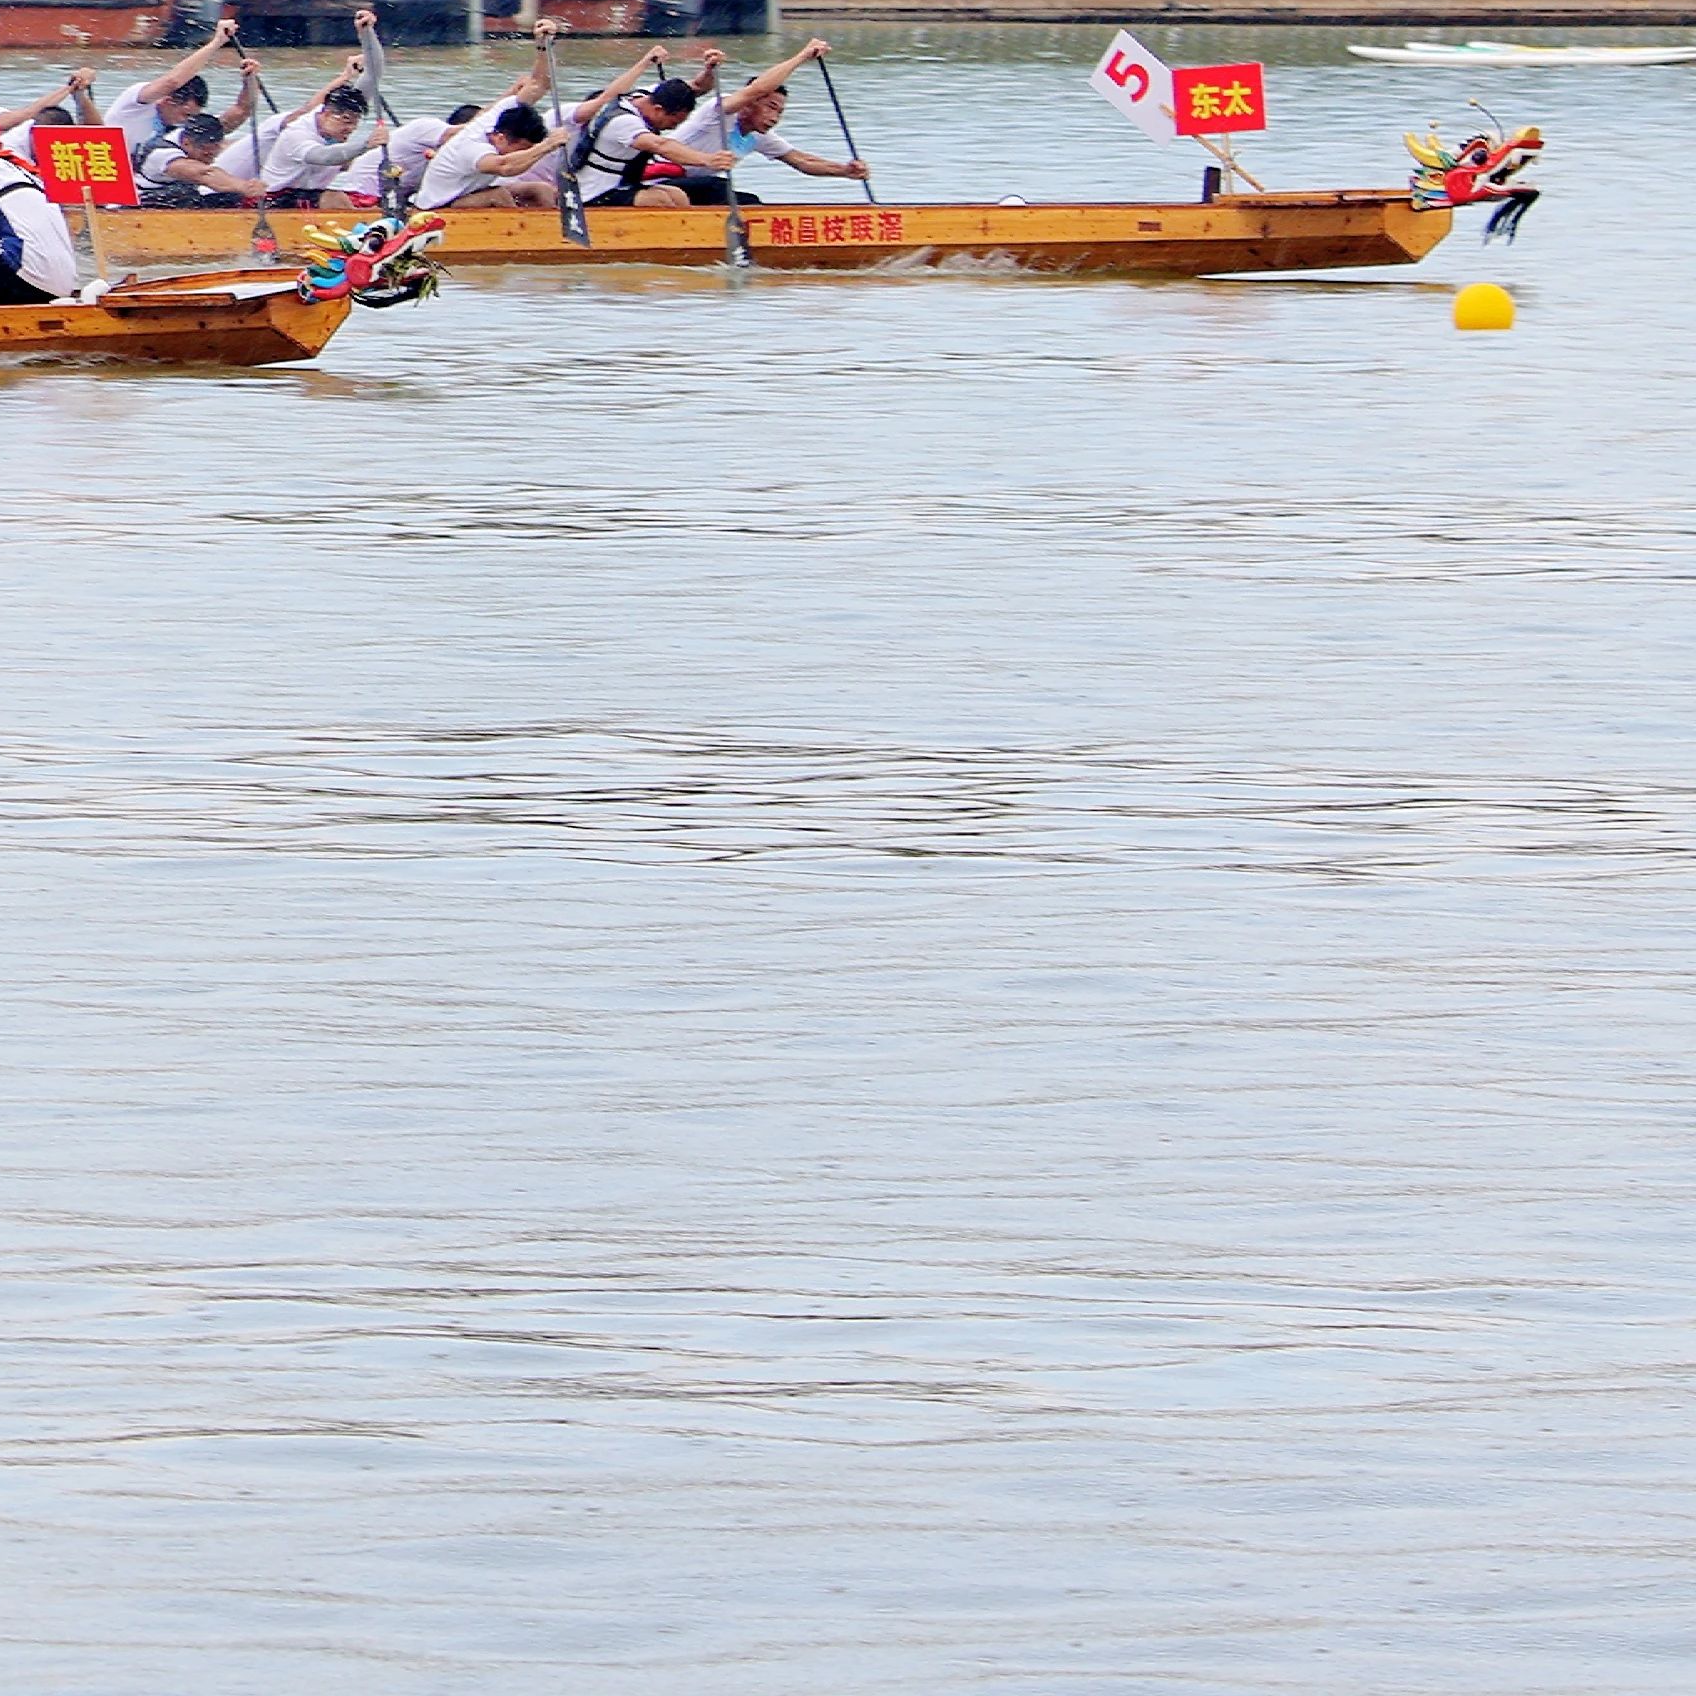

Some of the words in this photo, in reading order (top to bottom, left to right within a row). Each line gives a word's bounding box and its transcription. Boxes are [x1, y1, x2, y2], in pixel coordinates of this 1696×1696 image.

[1104, 49, 1150, 103] 5
[1189, 80, 1255, 120] 东太
[50, 140, 119, 182] 新基
